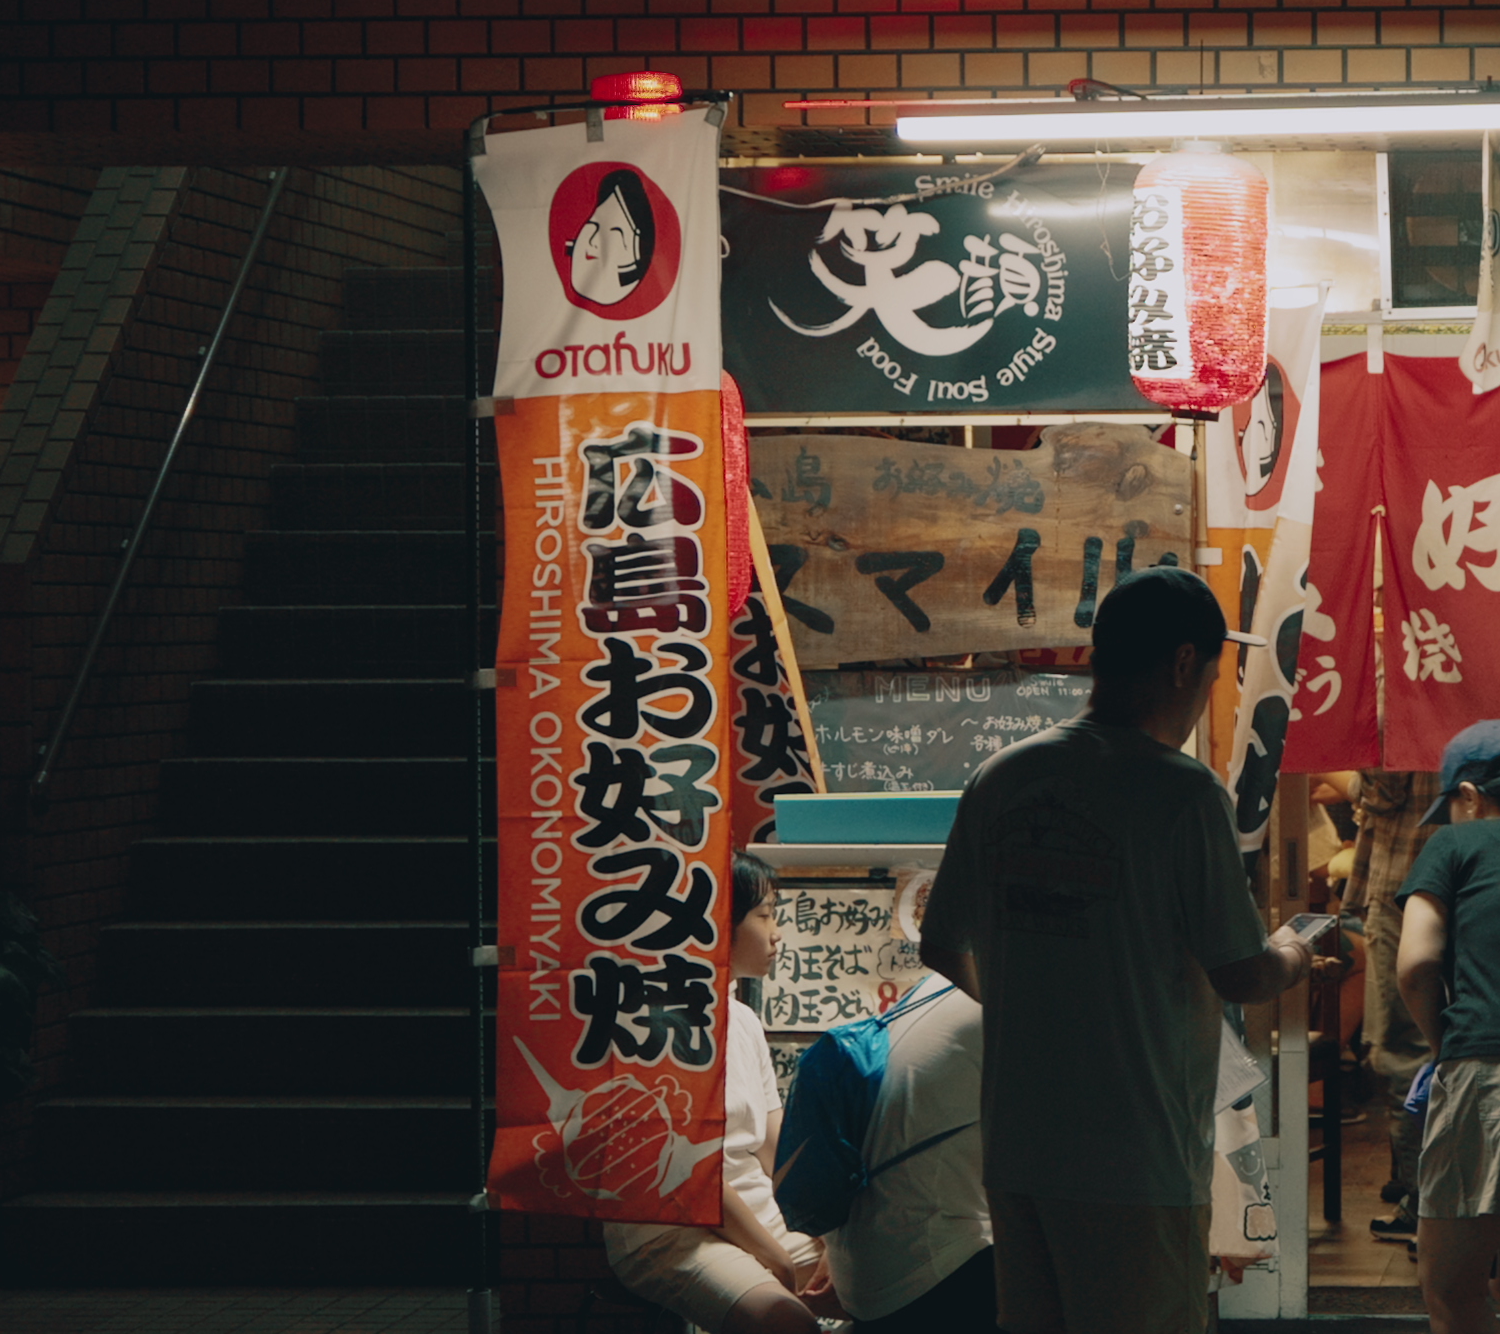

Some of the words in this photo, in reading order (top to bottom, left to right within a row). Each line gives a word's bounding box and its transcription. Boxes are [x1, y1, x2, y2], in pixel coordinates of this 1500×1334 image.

[1002, 189, 1067, 322] Hiroshima
[856, 336, 919, 395] Food
[997, 328, 1057, 387] Style
[927, 375, 990, 403] Soul
[528, 456, 564, 699] HIROSHIMA
[875, 674, 992, 704] MENU
[571, 421, 721, 1071] 広島お好み焼
[528, 711, 564, 1022] OKONOMIYAKI
[765, 985, 875, 1027] 肉玉うどん
